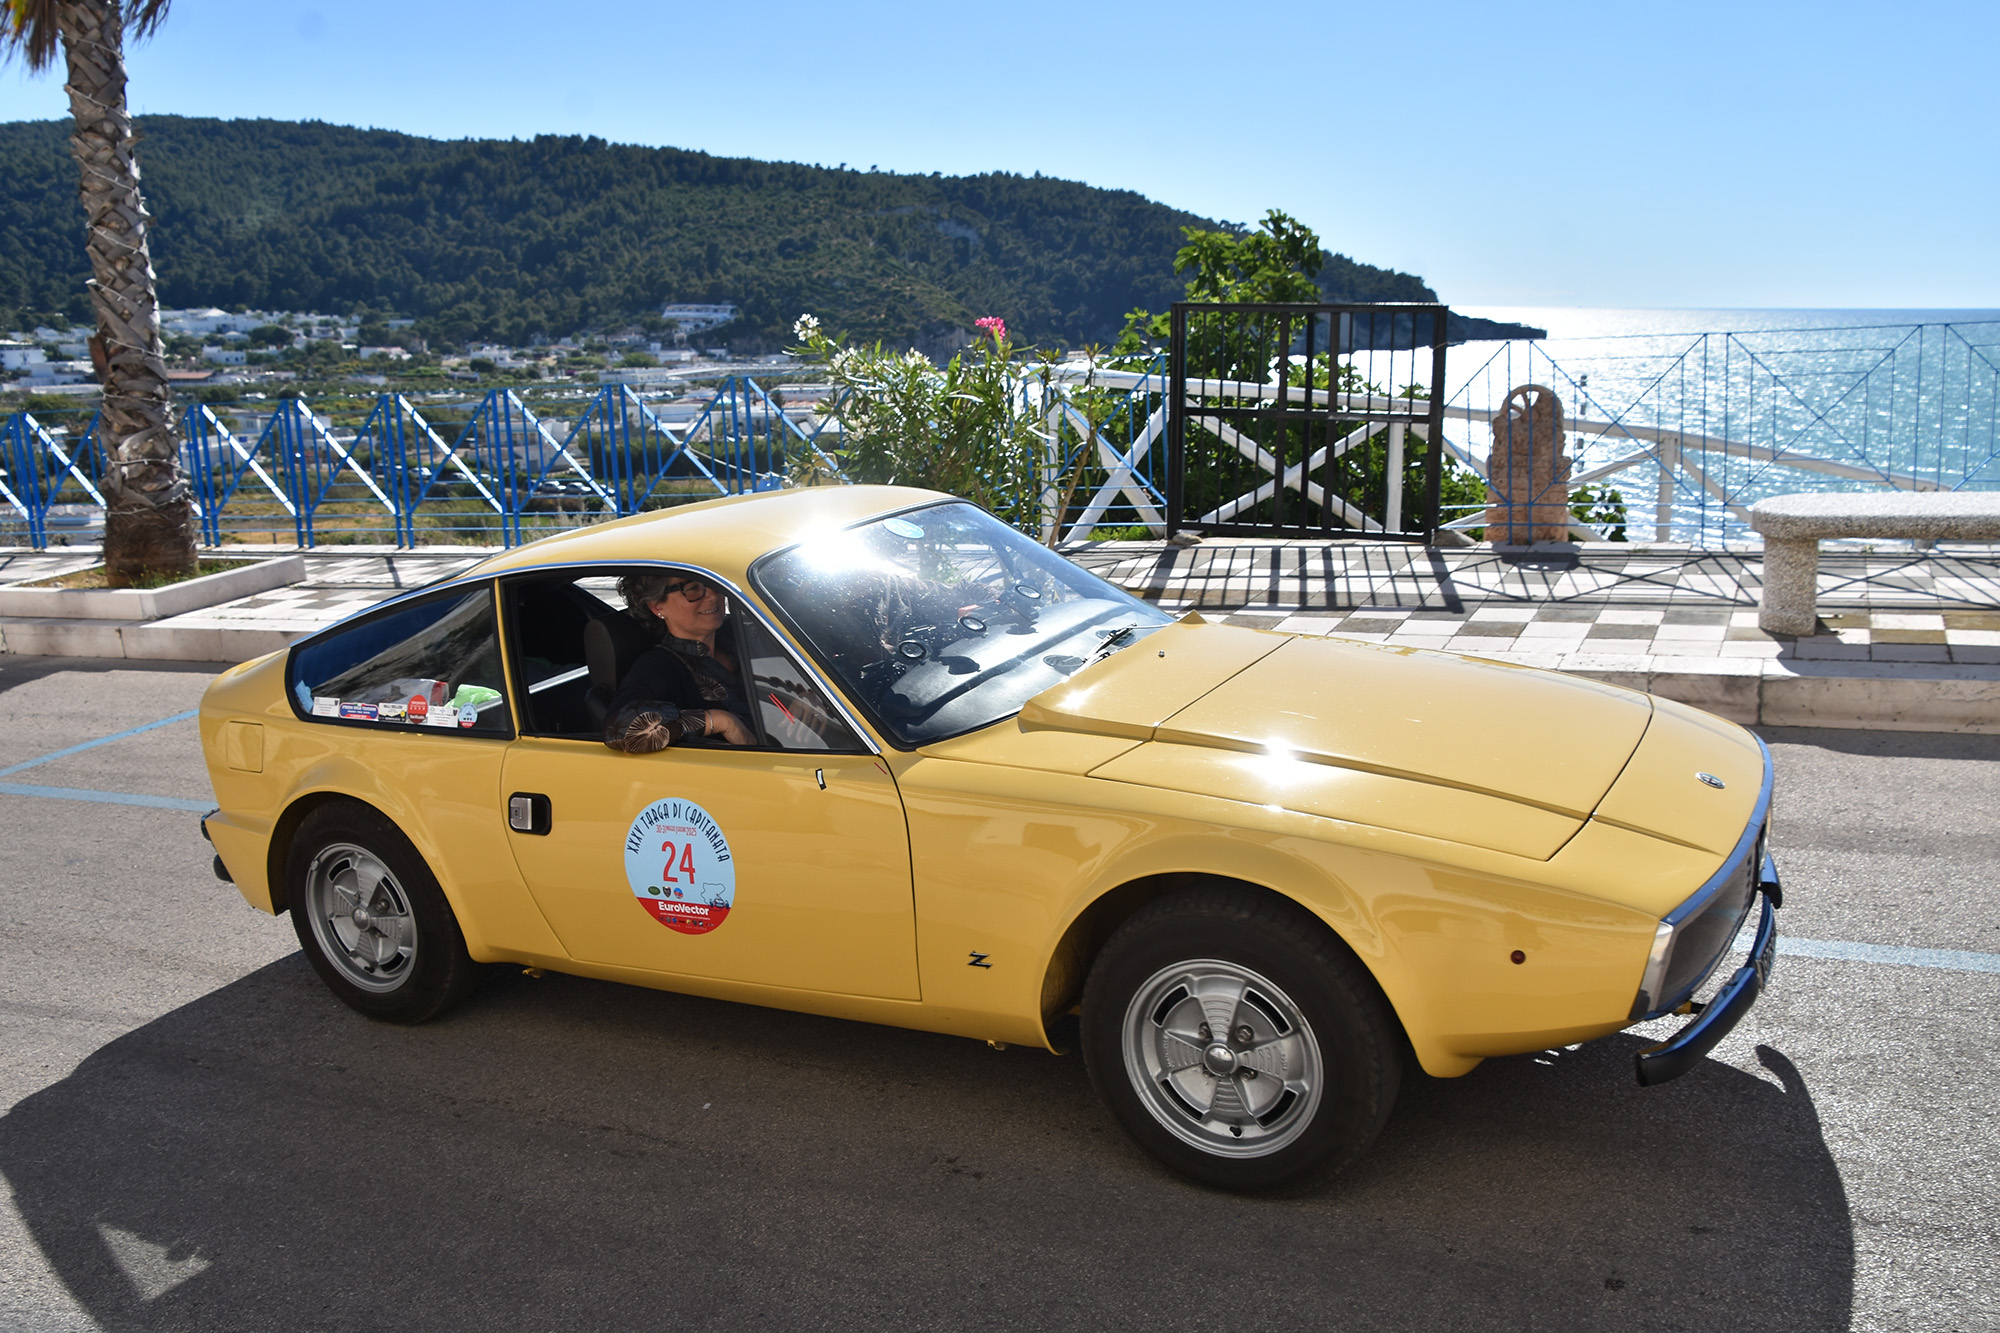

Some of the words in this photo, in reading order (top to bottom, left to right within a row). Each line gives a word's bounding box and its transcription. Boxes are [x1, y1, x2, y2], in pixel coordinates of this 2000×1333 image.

[626, 824, 645, 855] XXXV
[640, 802, 670, 830] TARGA
[673, 802, 682, 819] DI
[685, 805, 731, 863] CAPITANATA
[661, 840, 696, 885] 24
[658, 901, 710, 916] EuroVector
